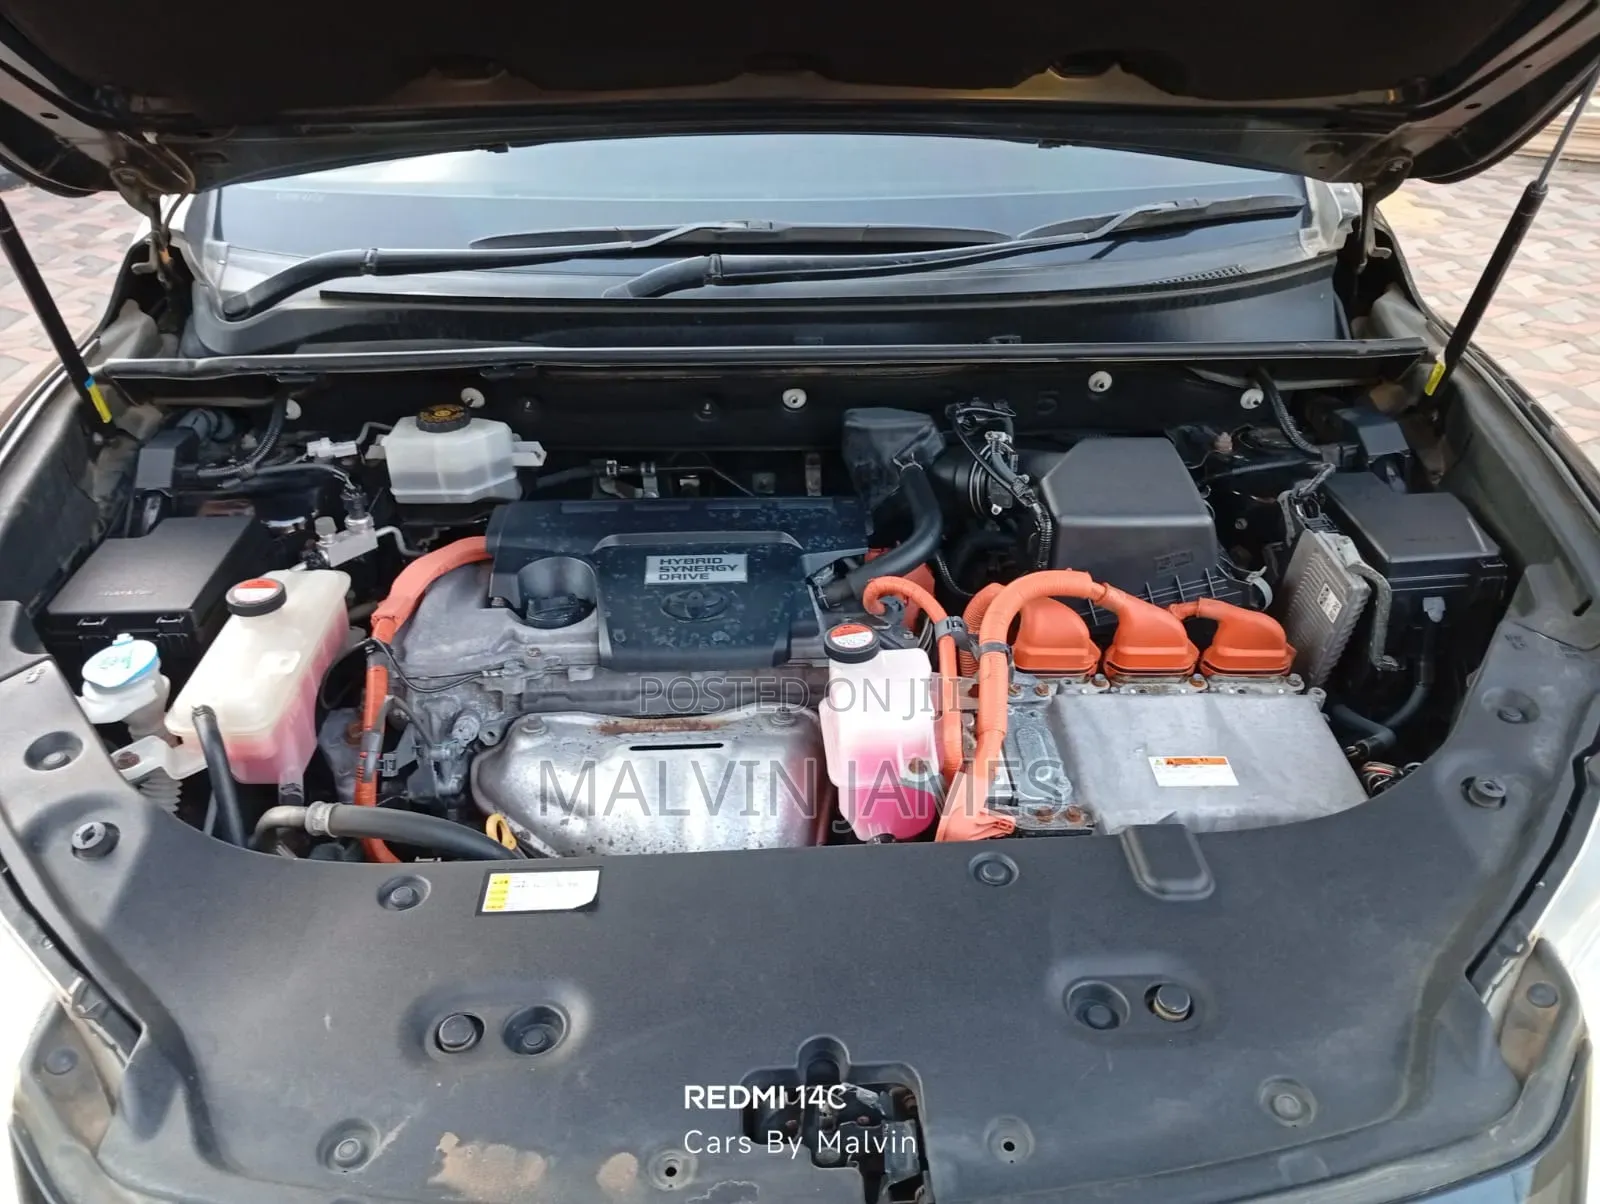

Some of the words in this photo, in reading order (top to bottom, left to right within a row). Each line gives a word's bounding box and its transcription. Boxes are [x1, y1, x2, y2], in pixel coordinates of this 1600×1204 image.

[659, 557, 723, 565] HYBRID
[659, 564, 738, 573] SYNERGY
[658, 573, 710, 581] DRIVE
